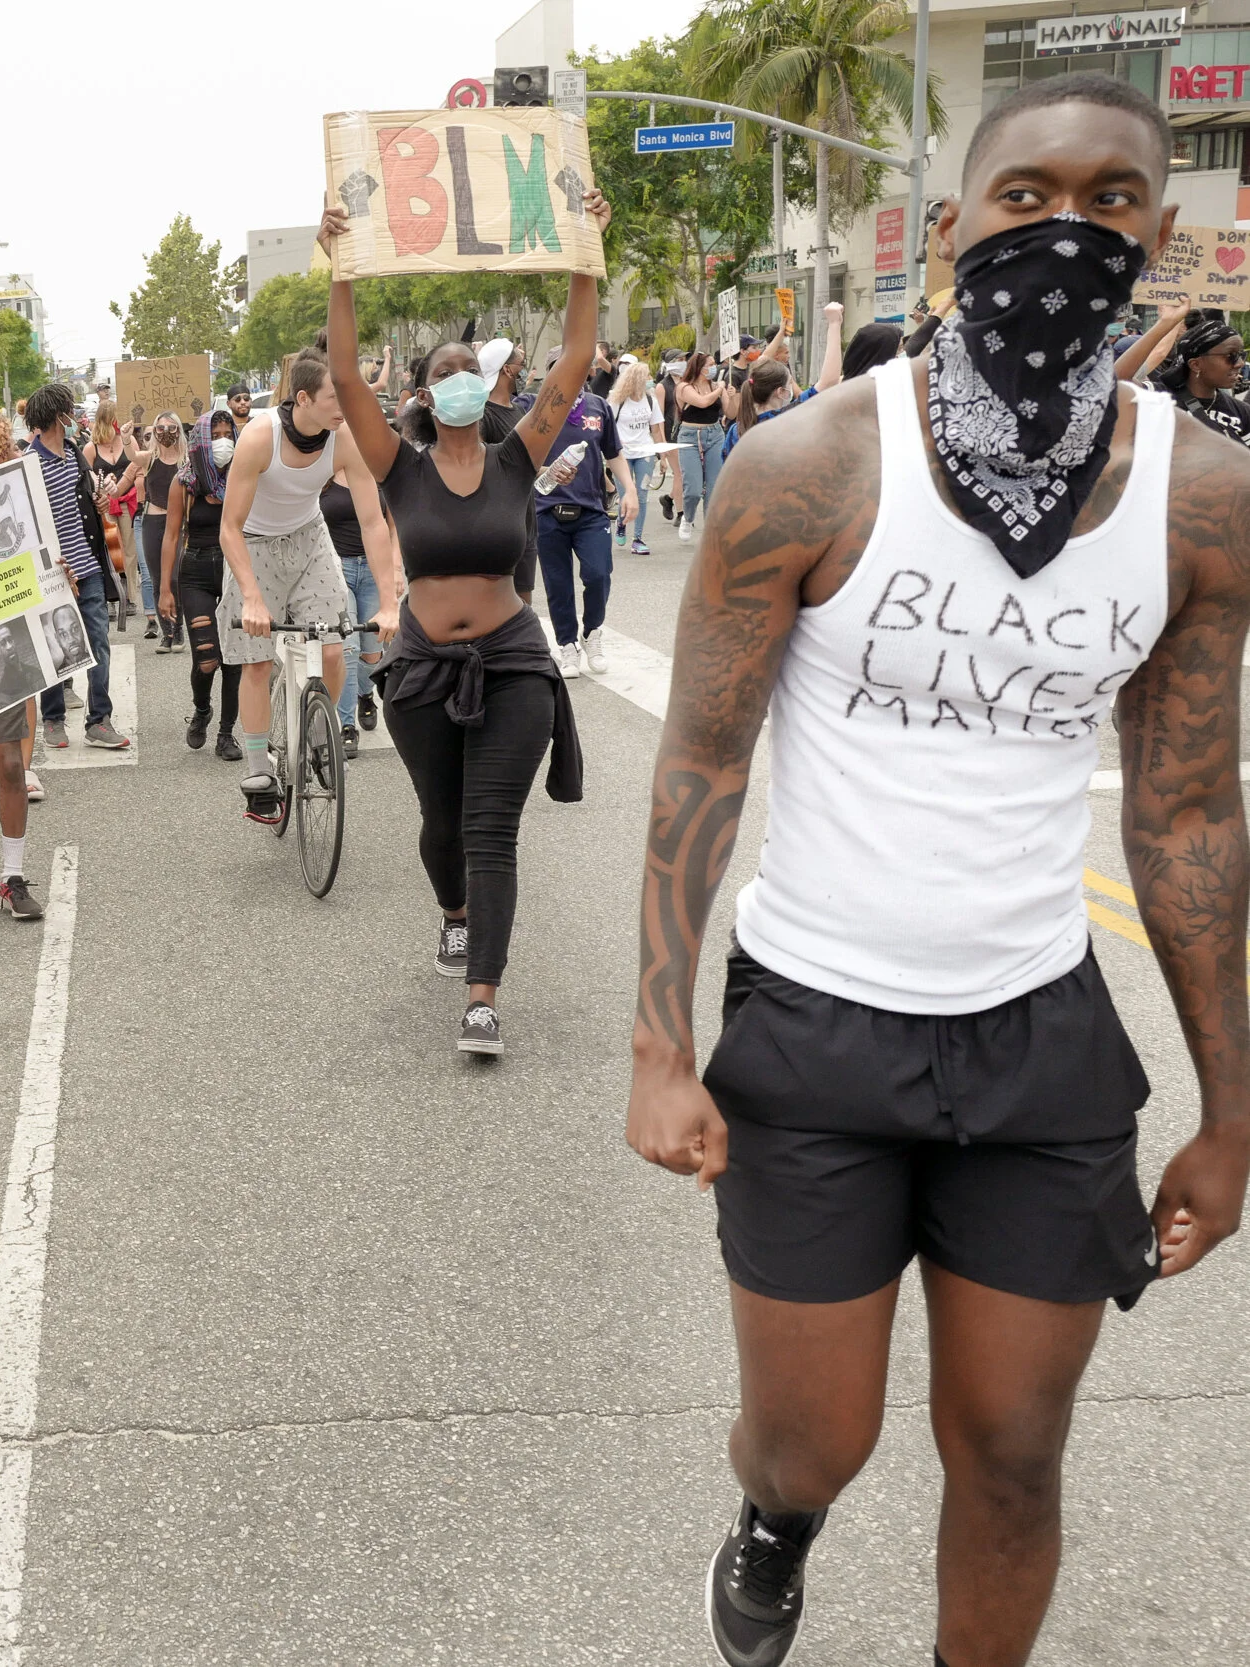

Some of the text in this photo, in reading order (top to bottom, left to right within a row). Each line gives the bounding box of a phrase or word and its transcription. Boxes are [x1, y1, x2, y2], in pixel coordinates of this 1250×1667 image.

[1040, 16, 1182, 44] HAPPY NAILS
[1050, 38, 1169, 56] AND SPA
[1169, 64, 1250, 100] RGET
[639, 129, 731, 146] Santa Monica Blvd
[376, 125, 563, 258] BLM
[876, 277, 906, 290] FOR LEASE
[875, 292, 906, 303] RESTAURANT
[141, 358, 180, 374] SKIN
[138, 372, 187, 389] TONE
[133, 384, 195, 402] IS NOT A
[145, 396, 188, 411] CRIME
[4, 580, 19, 592] DAY
[868, 568, 1143, 654] BLACK
[861, 639, 1135, 713] LIVES
